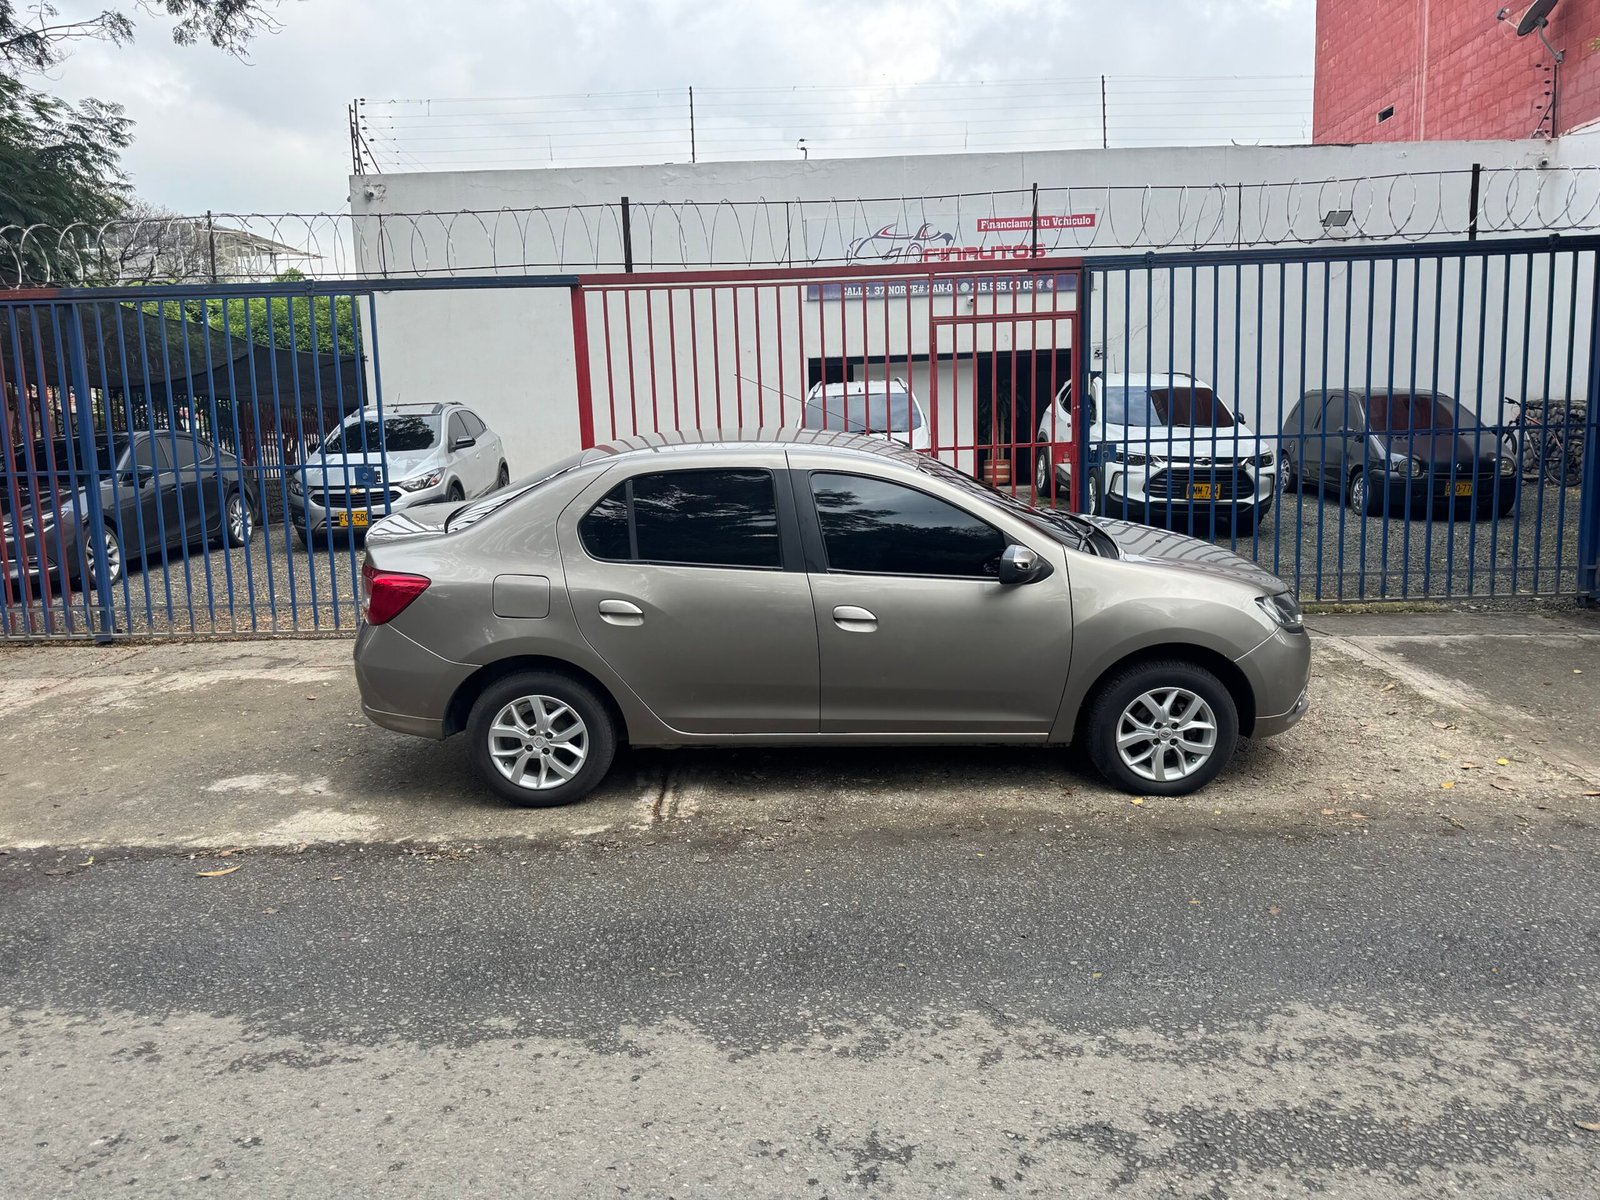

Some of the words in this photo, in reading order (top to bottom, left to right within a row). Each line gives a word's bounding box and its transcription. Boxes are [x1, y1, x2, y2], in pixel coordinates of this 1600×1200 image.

[980, 219, 1038, 230] Financiamo
[1041, 218, 1050, 227] tu
[874, 286, 885, 295] 37
